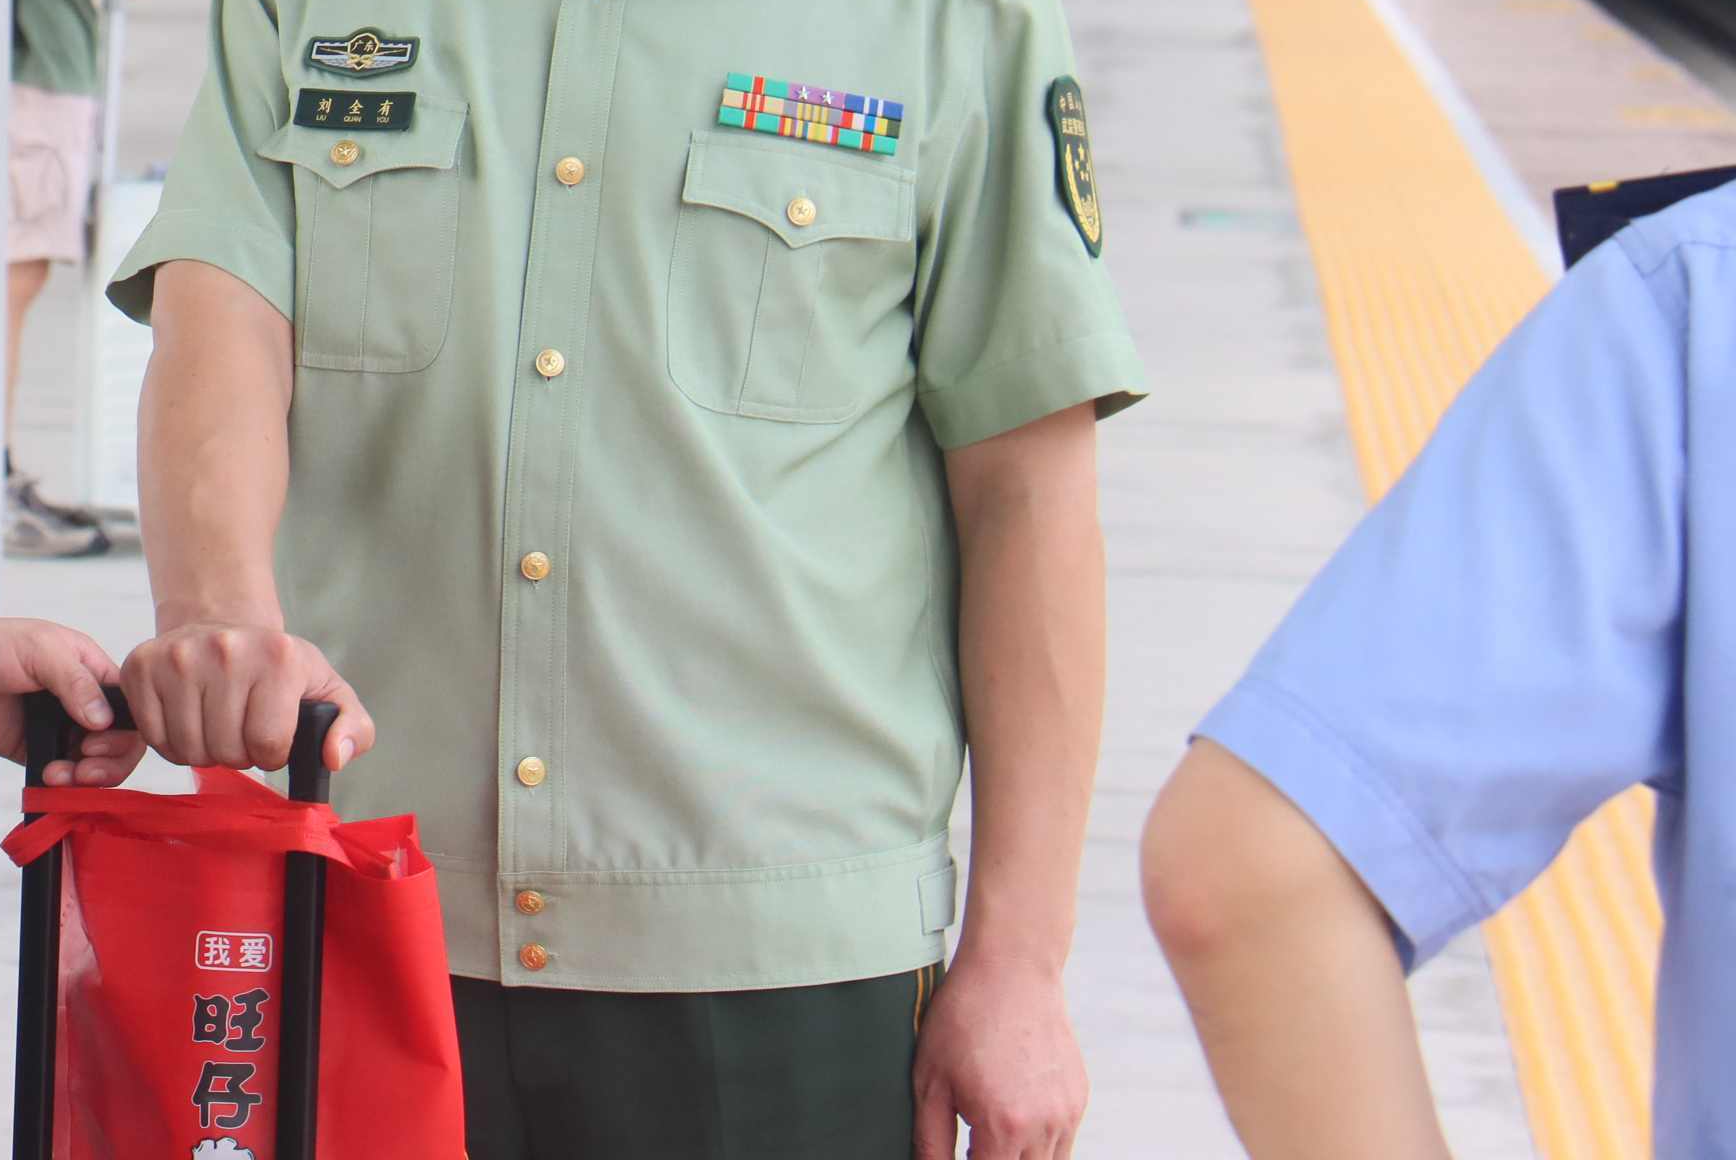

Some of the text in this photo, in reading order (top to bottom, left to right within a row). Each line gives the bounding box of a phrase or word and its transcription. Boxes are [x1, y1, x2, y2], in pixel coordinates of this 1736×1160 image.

[351, 40, 374, 52] 广东
[317, 98, 394, 116] 刘全有
[204, 936, 267, 968] 我爱
[191, 987, 271, 1129] 旺仔
